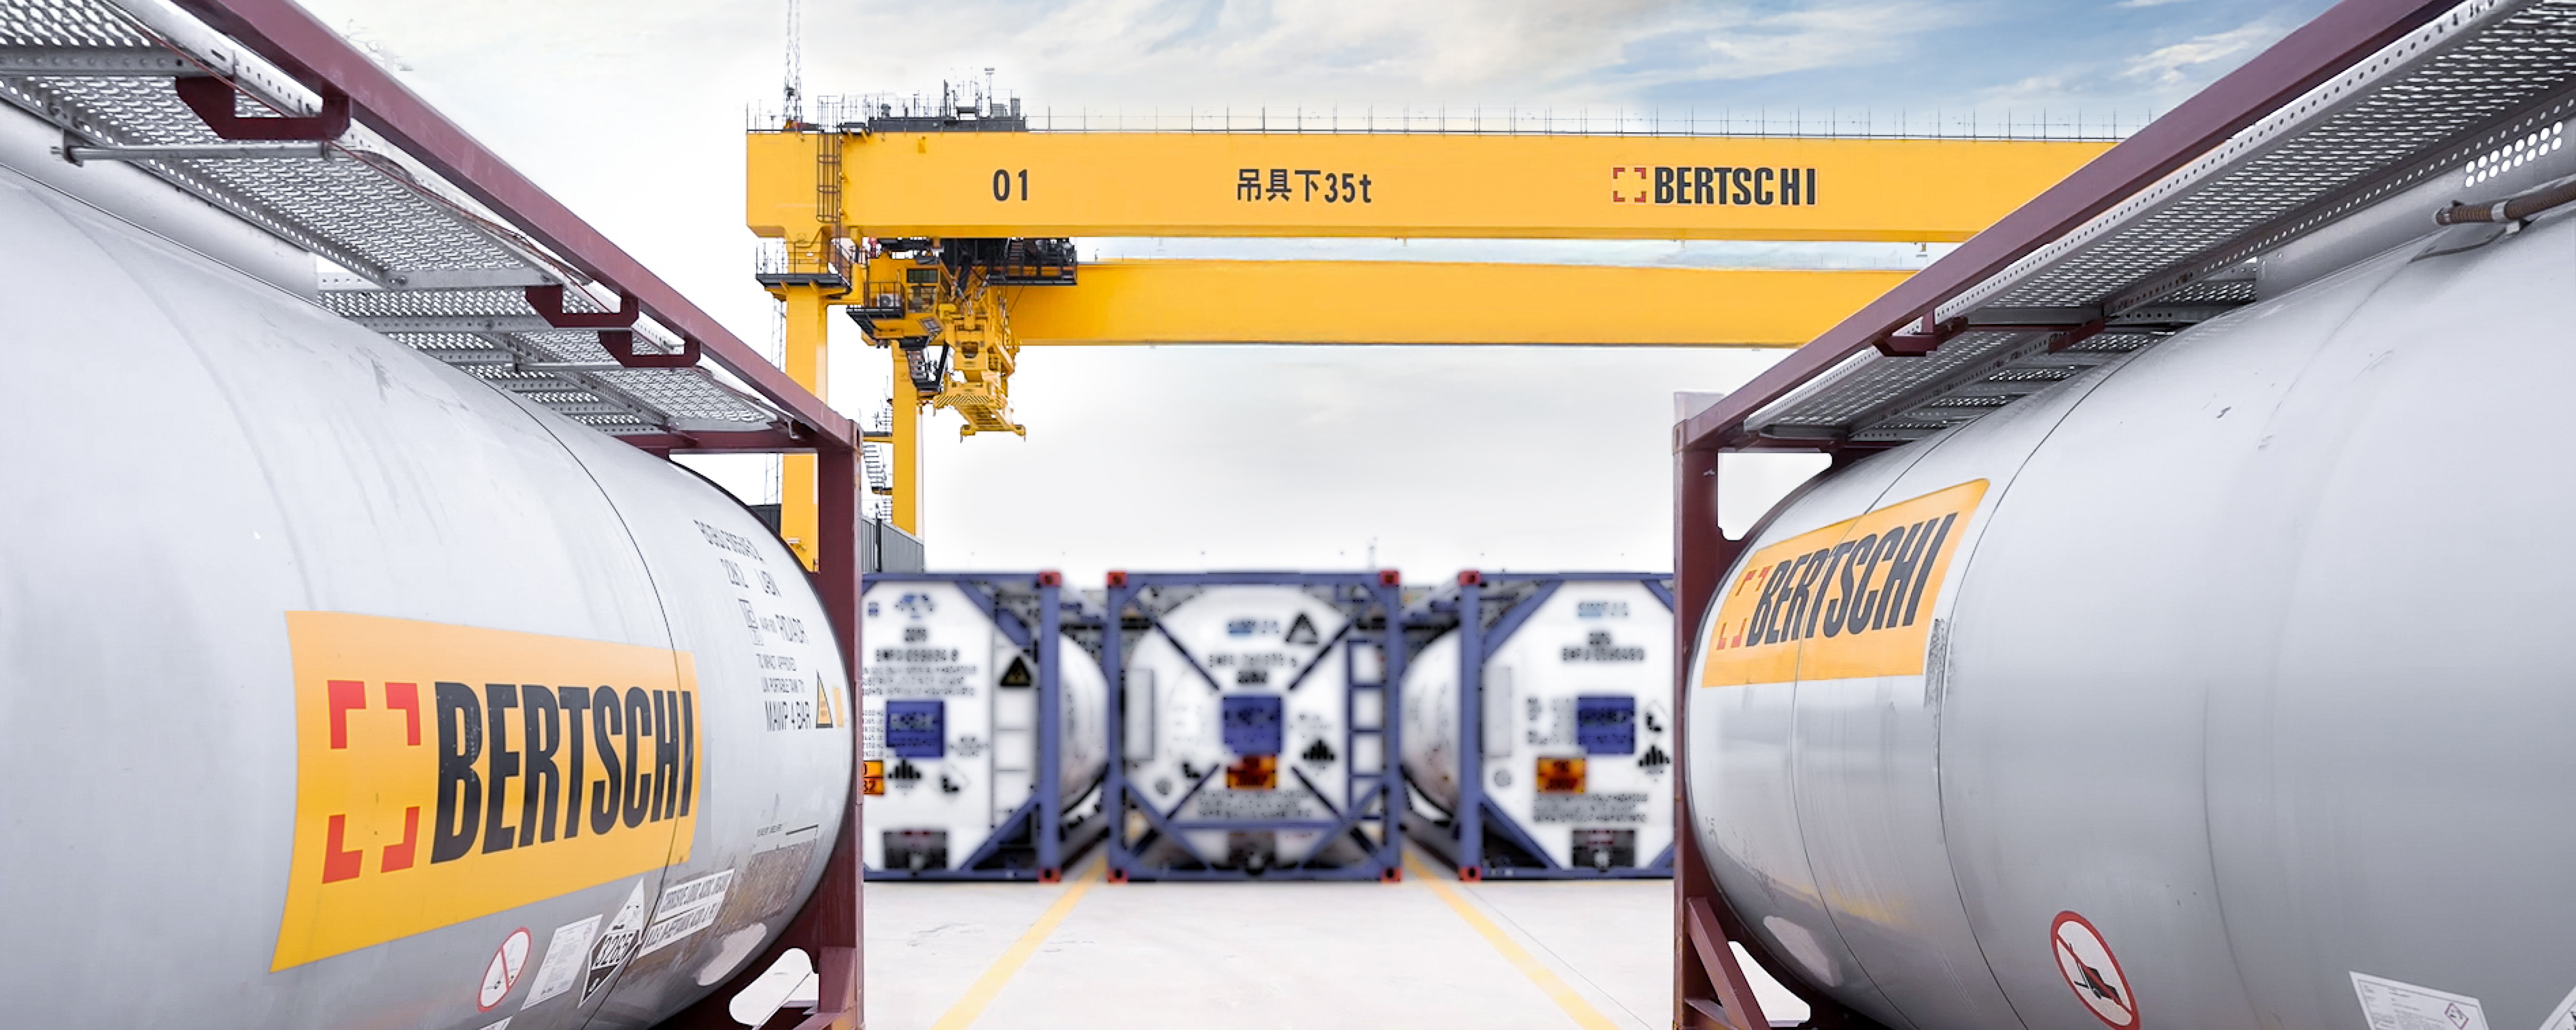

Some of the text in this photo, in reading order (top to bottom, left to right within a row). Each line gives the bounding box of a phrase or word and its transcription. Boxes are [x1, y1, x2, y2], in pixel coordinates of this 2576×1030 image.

[992, 169, 1029, 202] 01
[1236, 168, 1372, 203] 吊具下35t
[1655, 167, 1816, 205] BERTSCHI
[1745, 512, 1959, 647] BERTSCHI
[796, 701, 811, 730] BAR
[431, 681, 694, 864] BERTSCHI
[595, 932, 634, 966] 3265
